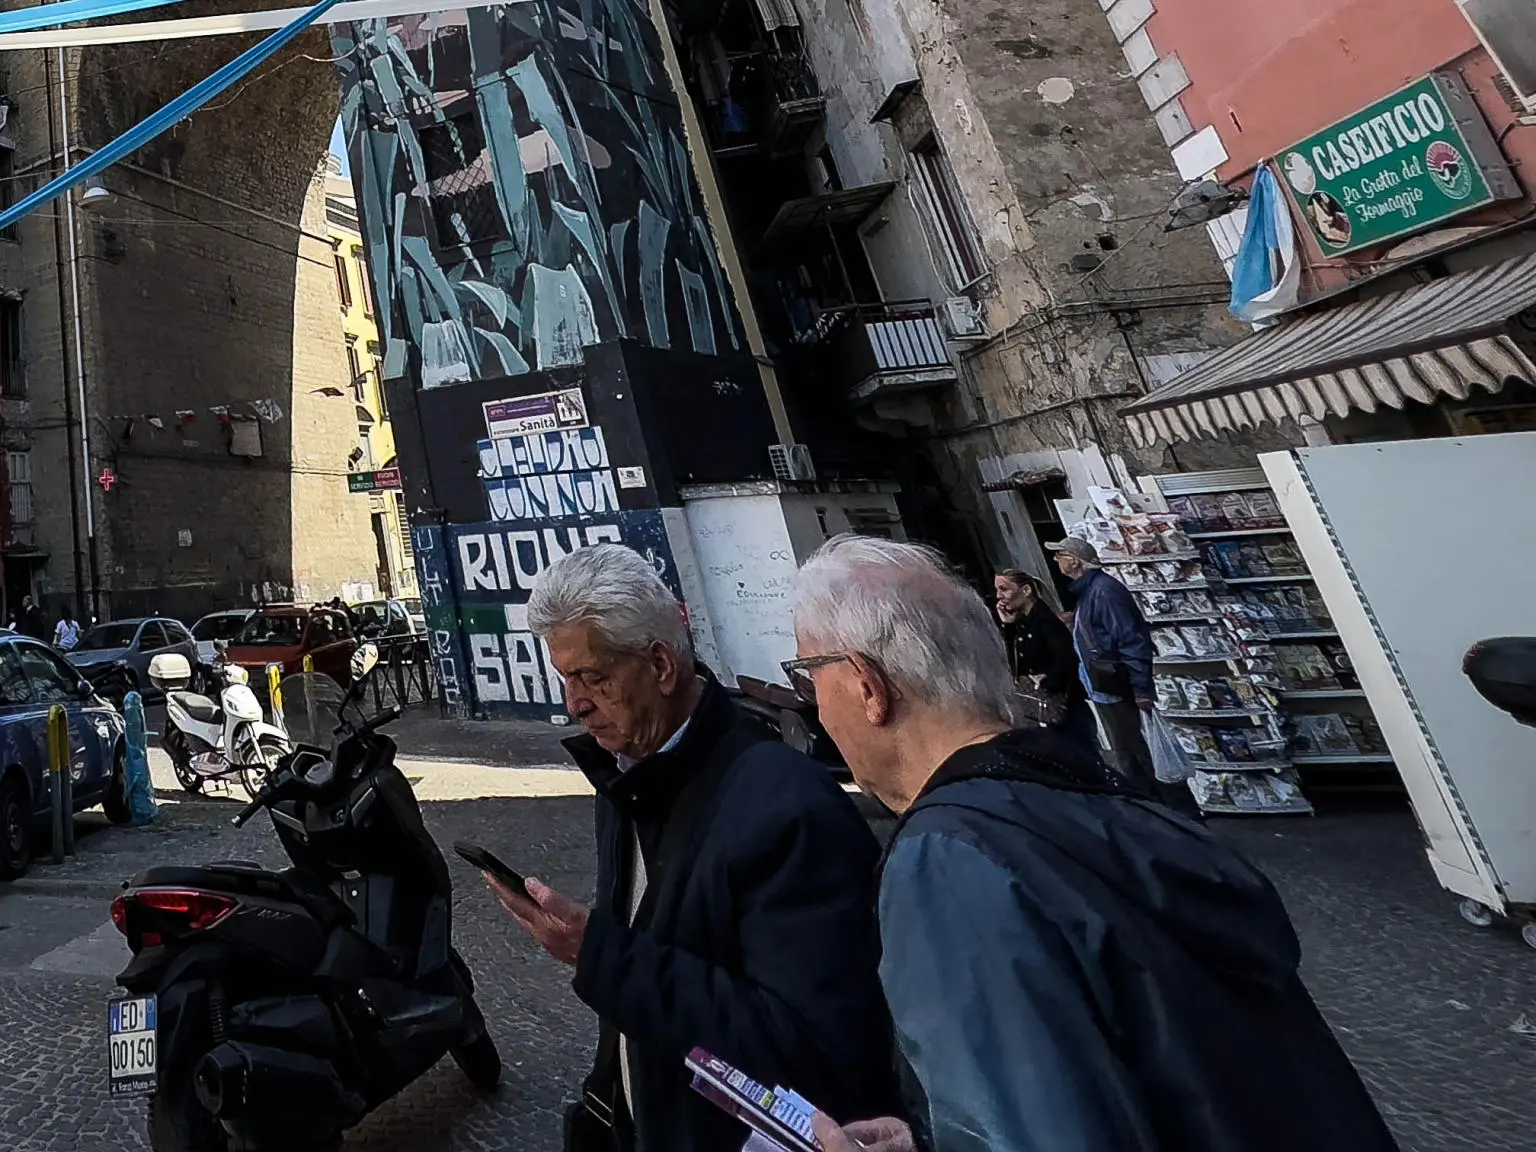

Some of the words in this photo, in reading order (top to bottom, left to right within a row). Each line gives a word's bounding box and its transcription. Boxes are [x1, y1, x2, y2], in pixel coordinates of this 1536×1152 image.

[1311, 92, 1445, 181] CASEIFICIO
[1342, 186, 1362, 207] La
[1402, 155, 1424, 179] del
[519, 416, 556, 433] Sanità
[458, 524, 622, 591] RION
[120, 1001, 138, 1031] ED
[112, 1037, 154, 1071] 00150
